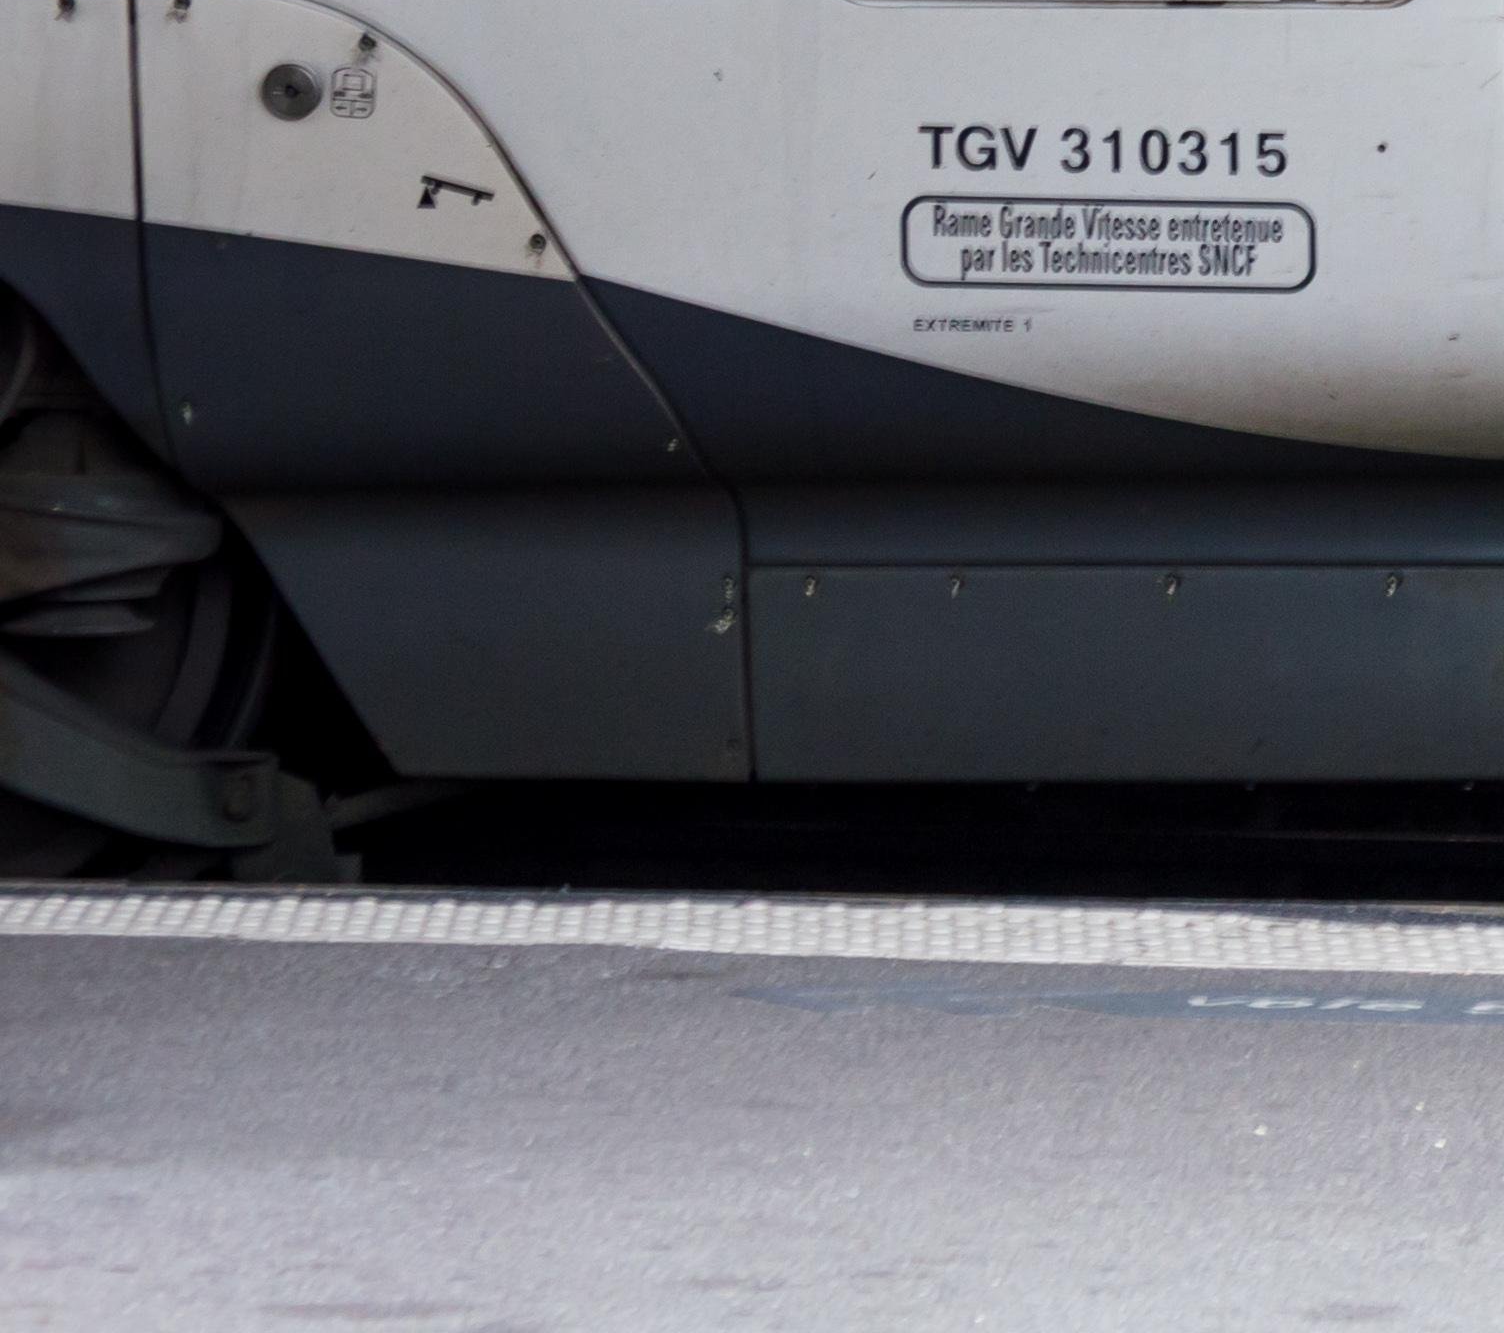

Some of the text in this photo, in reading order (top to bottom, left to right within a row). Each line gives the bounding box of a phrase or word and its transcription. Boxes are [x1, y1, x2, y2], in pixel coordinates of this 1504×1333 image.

[918, 126, 1288, 176] TGV 310315
[933, 204, 1284, 244] Rame Grande Vitesse entretenue
[960, 243, 1257, 280] par les Technicentres SNCF
